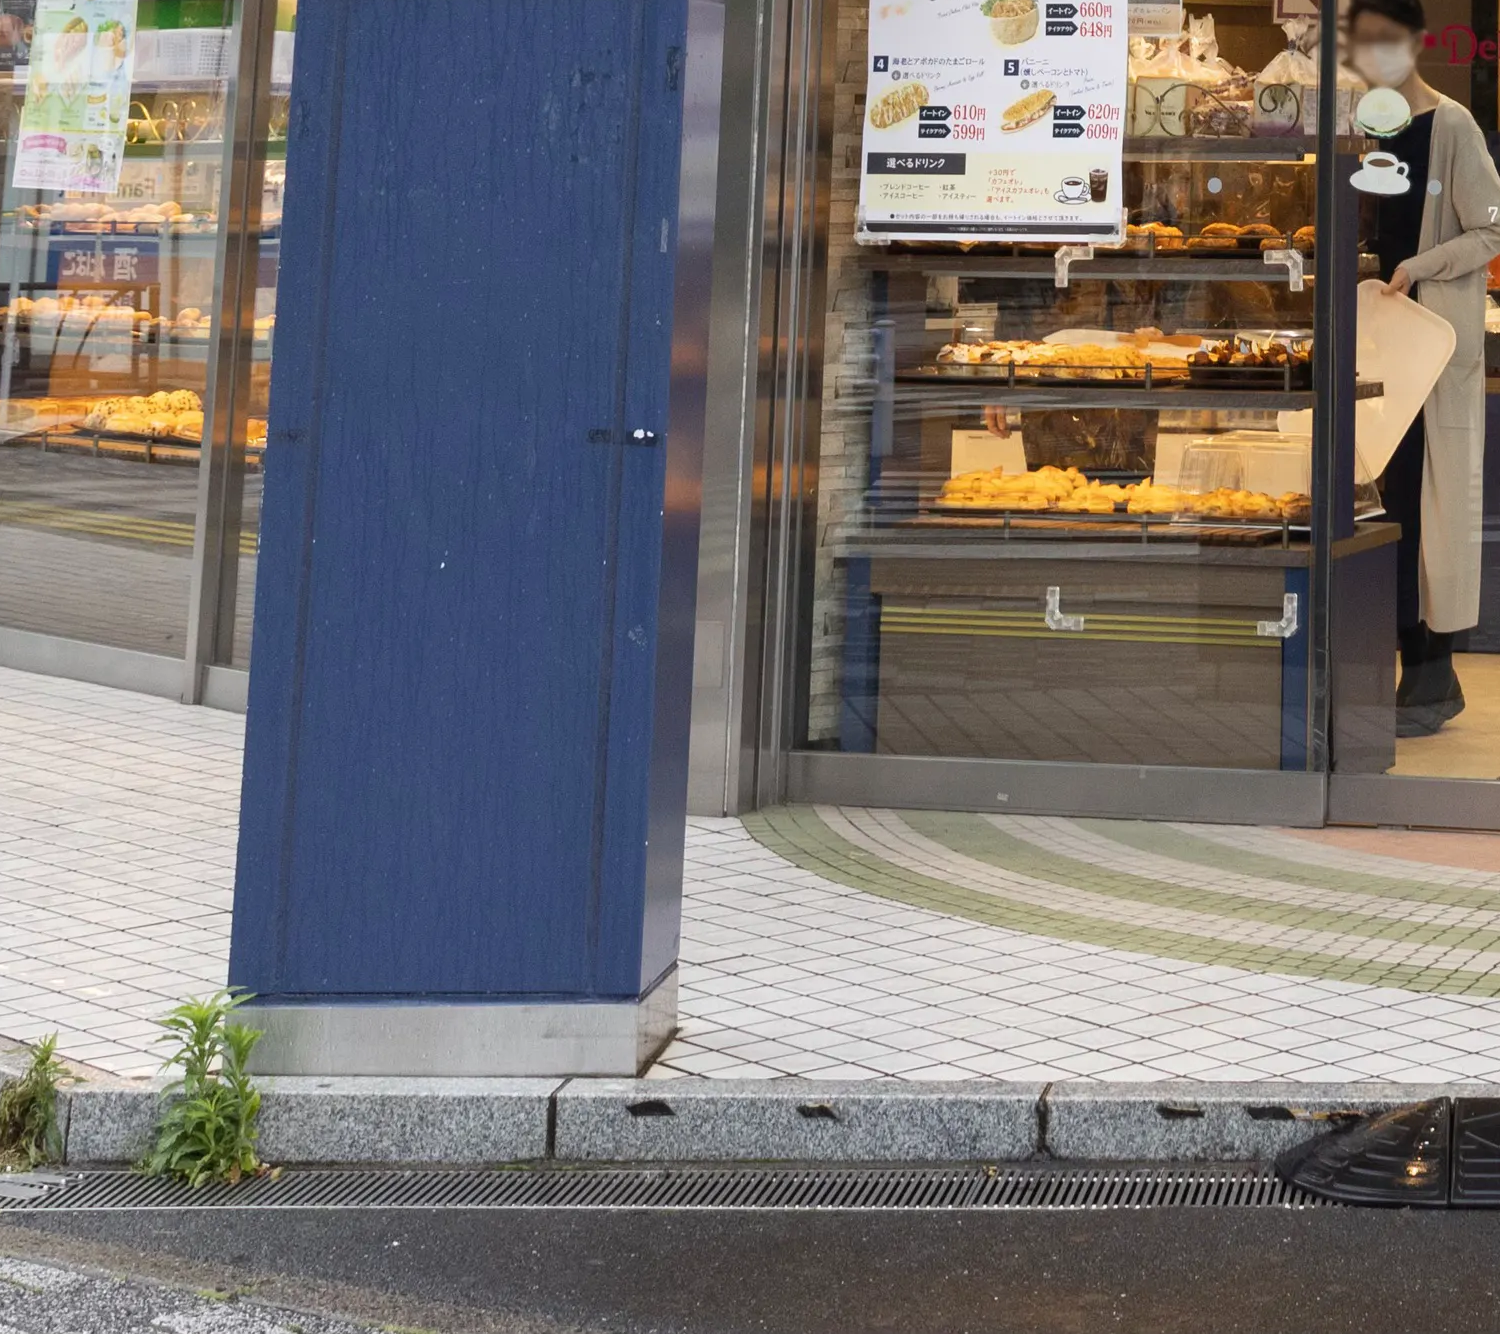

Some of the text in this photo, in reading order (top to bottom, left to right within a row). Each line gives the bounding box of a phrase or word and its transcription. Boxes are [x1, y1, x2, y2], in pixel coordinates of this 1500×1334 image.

[1047, 2, 1113, 18] イートイン 660円
[1047, 21, 1113, 38] テイクアウト 648円
[902, 71, 941, 80] 選べるドリンク
[1031, 80, 1070, 89] 選べるドリンク
[921, 104, 986, 121] イートイン 610円
[1055, 104, 1120, 121] イートイン 620円
[920, 123, 985, 140] テイクアウト 599円
[1054, 123, 1118, 140] テイクアウト 609円
[886, 157, 945, 169] 選べるドリンク
